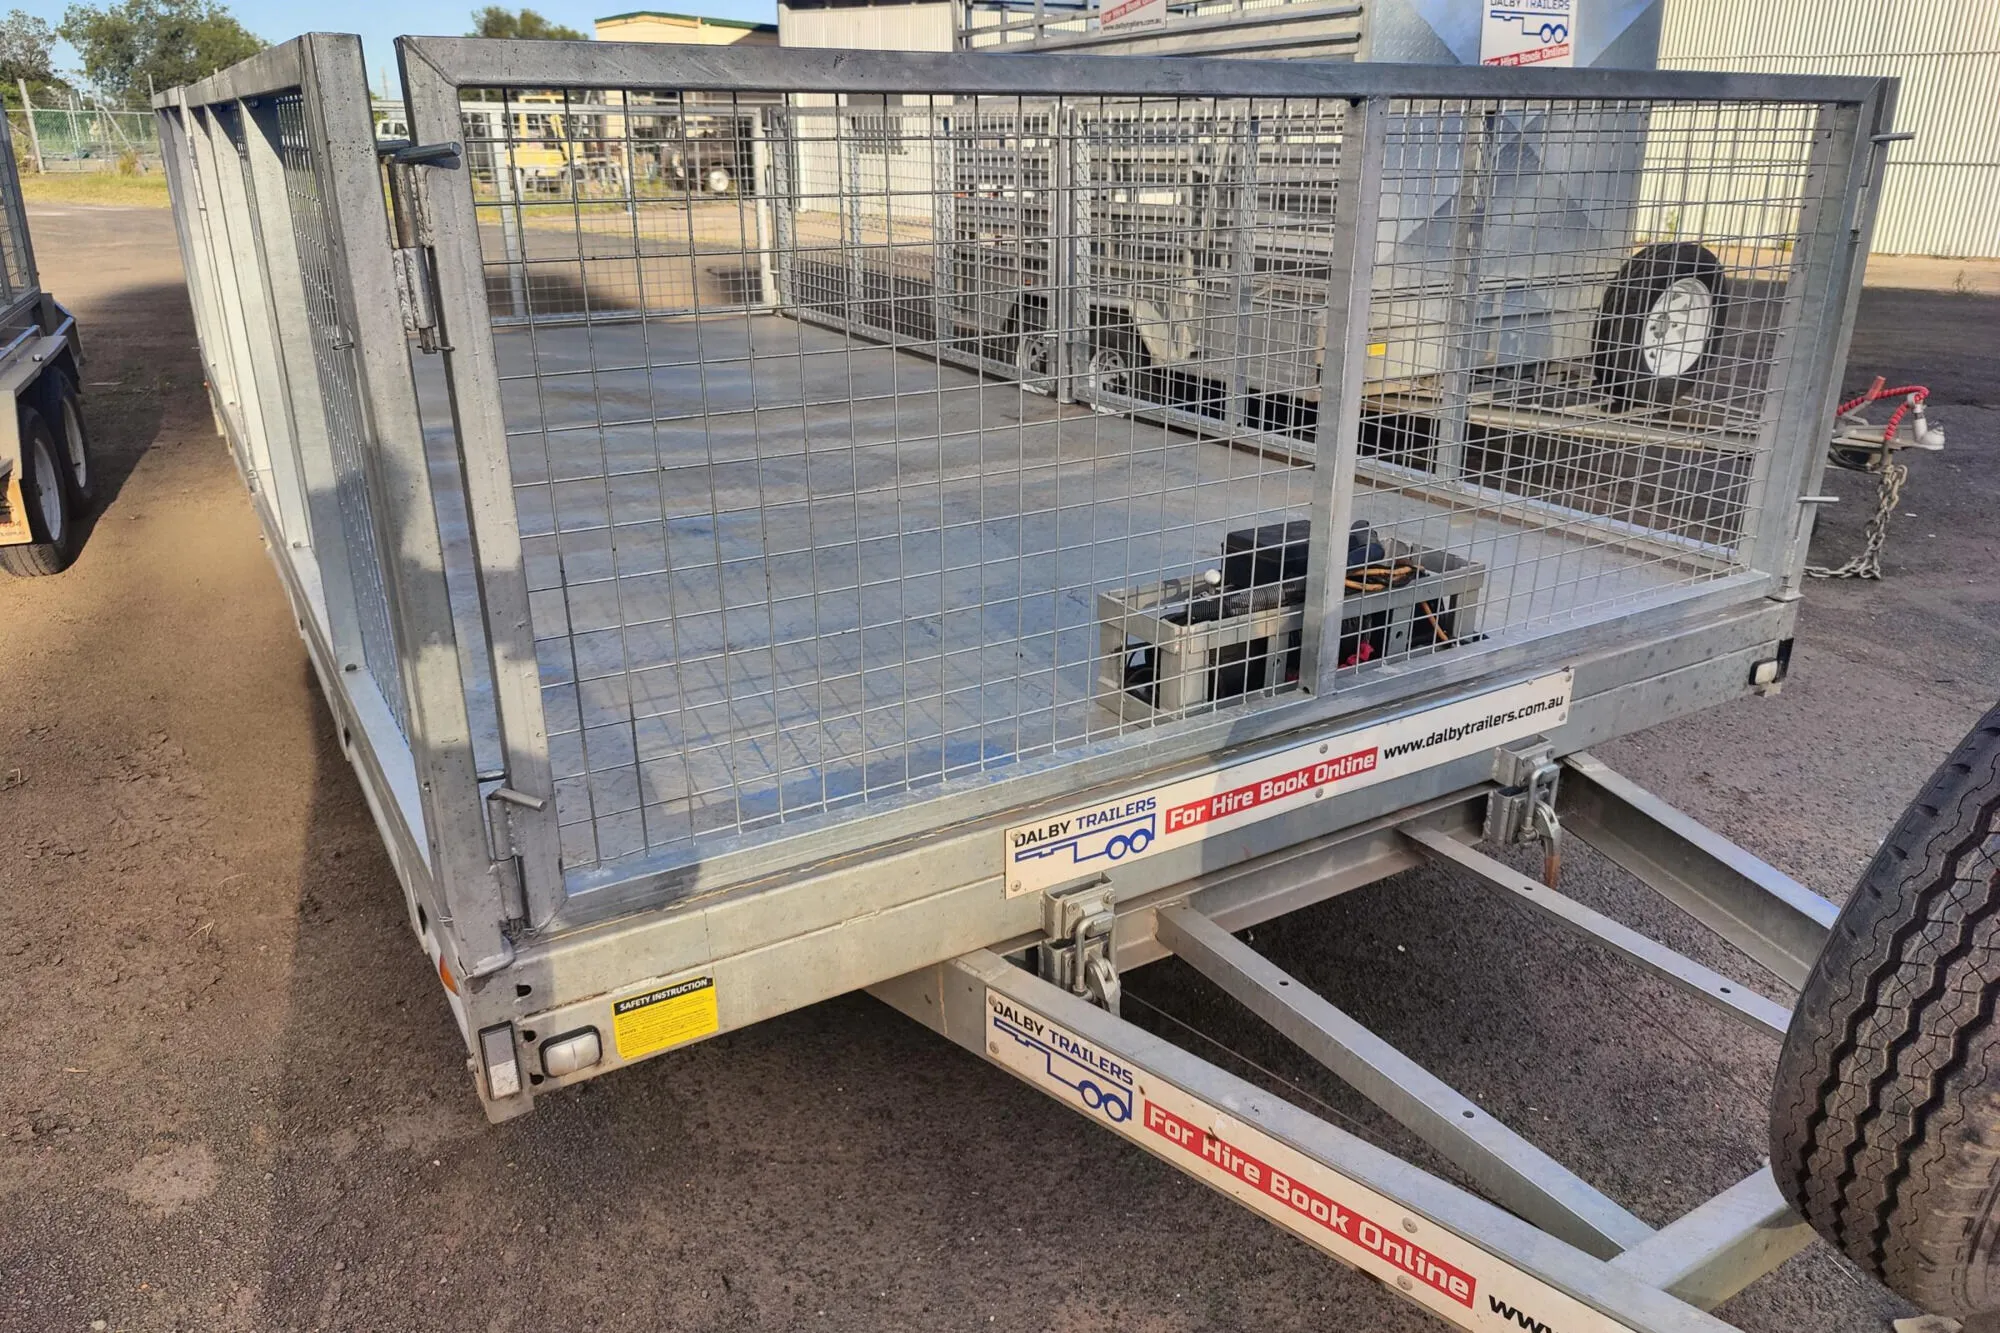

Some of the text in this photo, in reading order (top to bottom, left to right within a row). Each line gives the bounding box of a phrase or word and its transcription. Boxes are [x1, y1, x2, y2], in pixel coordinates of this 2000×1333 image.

[1526, 0, 1570, 10] TRAILERS
[1500, 55, 1519, 66] Hire
[1519, 51, 1541, 64] Book
[1542, 46, 1568, 59] Online
[1015, 695, 1564, 848] DALBY TRAILERS For Hire Book Online www.dalbytrailers.com.au
[619, 978, 708, 1012] SAFETY INSTRUCTION
[993, 1001, 1044, 1036] DALBY
[1049, 1029, 1134, 1086] TRAILERS
[1149, 1105, 1194, 1145] For
[1202, 1134, 1262, 1184] Hire
[1270, 1171, 1350, 1234] Book
[1358, 1220, 1470, 1300] Online
